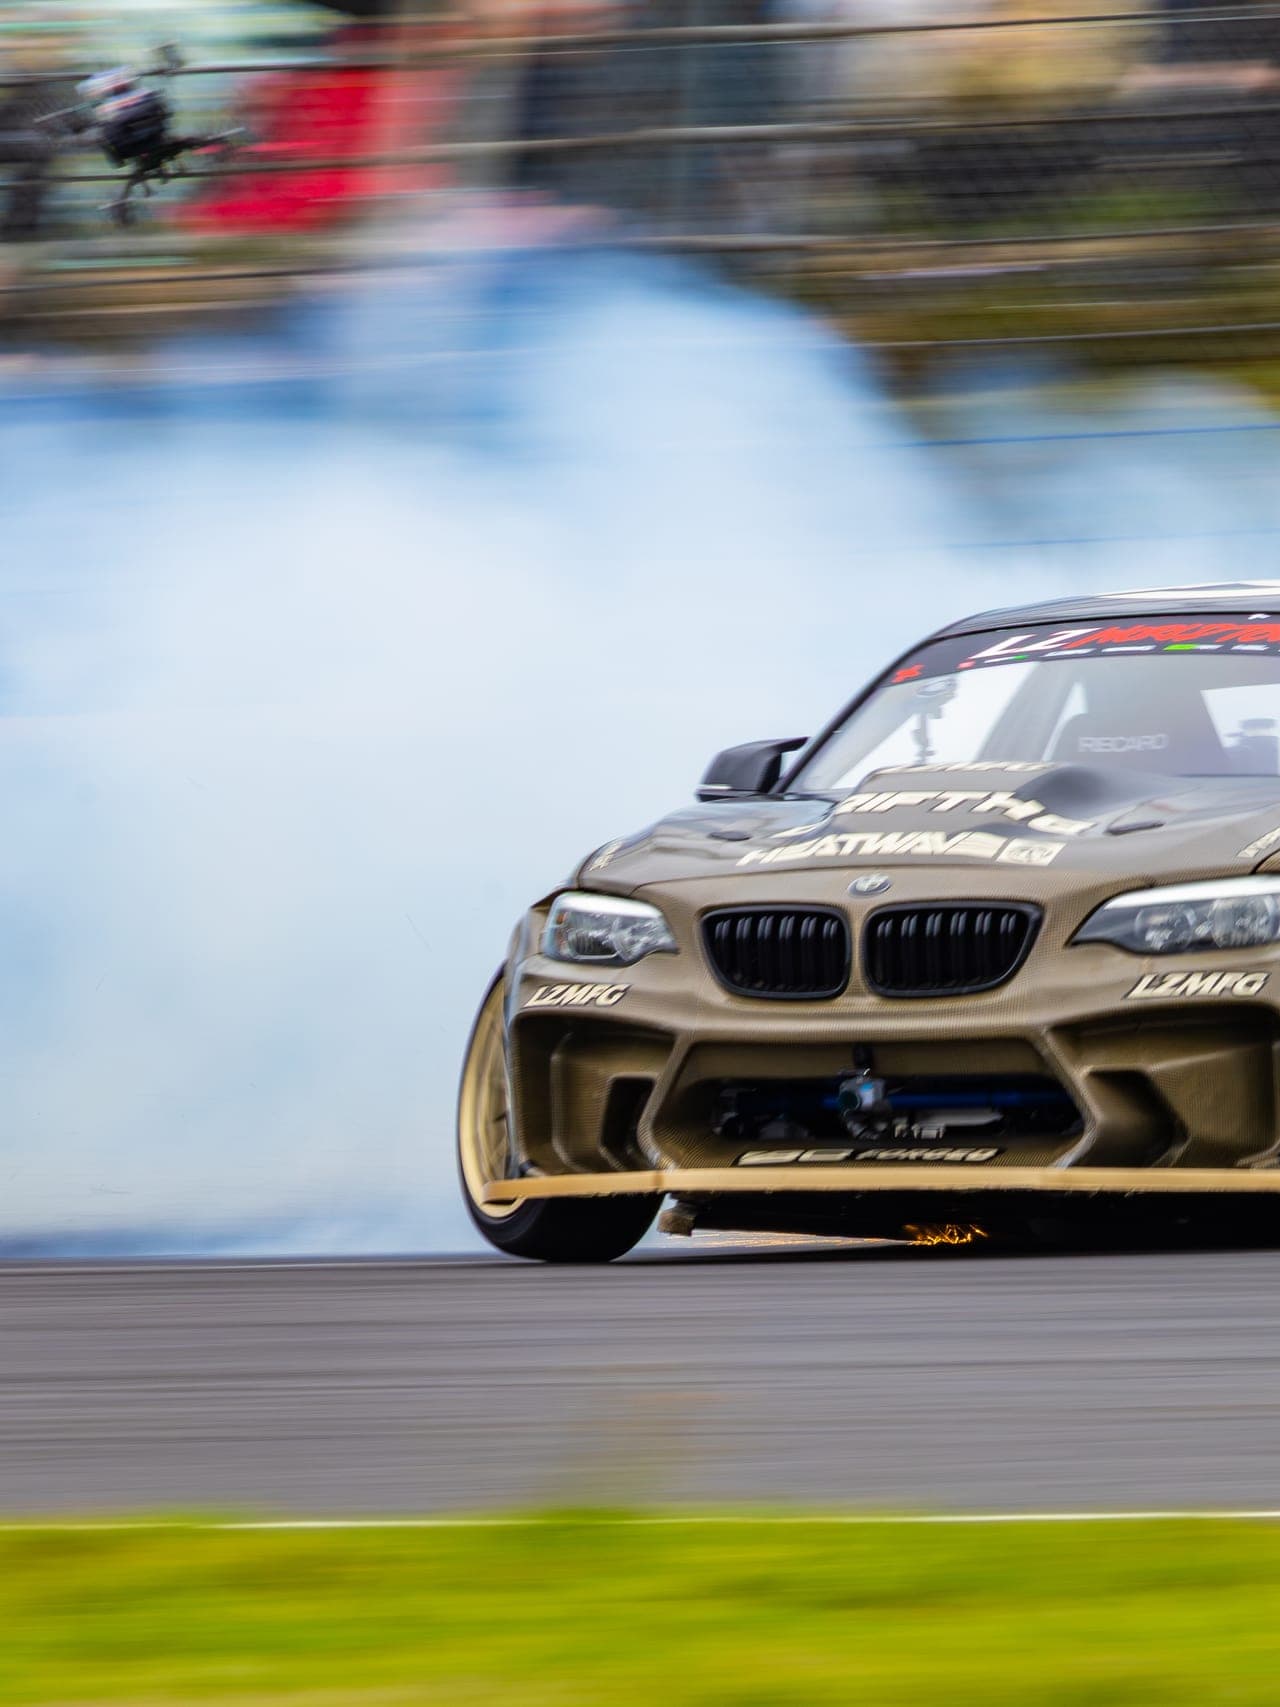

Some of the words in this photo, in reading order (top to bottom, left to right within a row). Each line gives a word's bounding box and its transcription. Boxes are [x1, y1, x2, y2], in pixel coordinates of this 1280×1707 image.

[1078, 734, 1168, 752] RECARO
[736, 831, 1009, 866] HEATWAVE
[523, 983, 631, 1007] LZMFG
[1126, 972, 1270, 999] LZMFG
